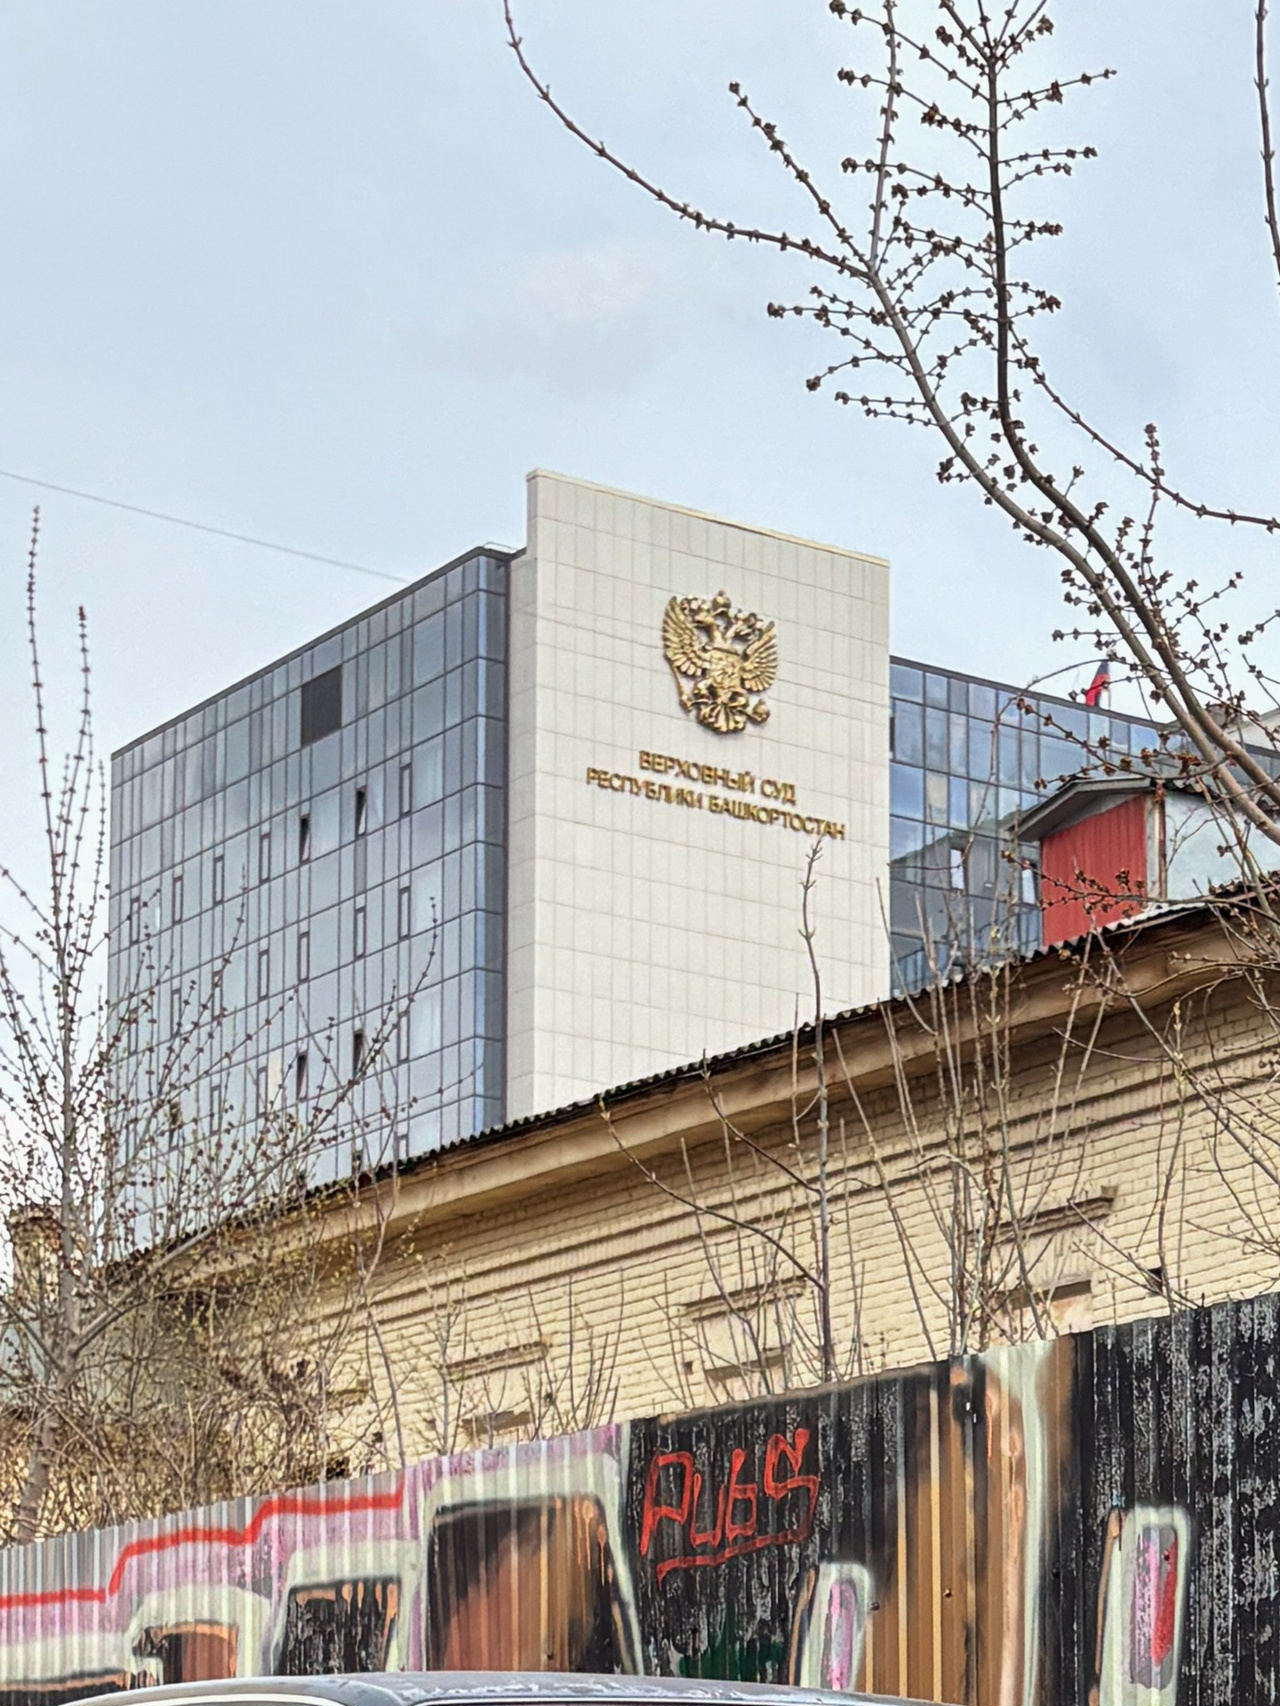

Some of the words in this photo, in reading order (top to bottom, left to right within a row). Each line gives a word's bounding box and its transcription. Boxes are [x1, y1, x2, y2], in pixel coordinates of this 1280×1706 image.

[586, 767, 703, 809] РЕСПУБЛИКИ
[708, 795, 845, 840] БАШКОРТОСТАН
[639, 750, 755, 794] ВЕРХОВНЫЙ
[760, 778, 796, 806] СУД
